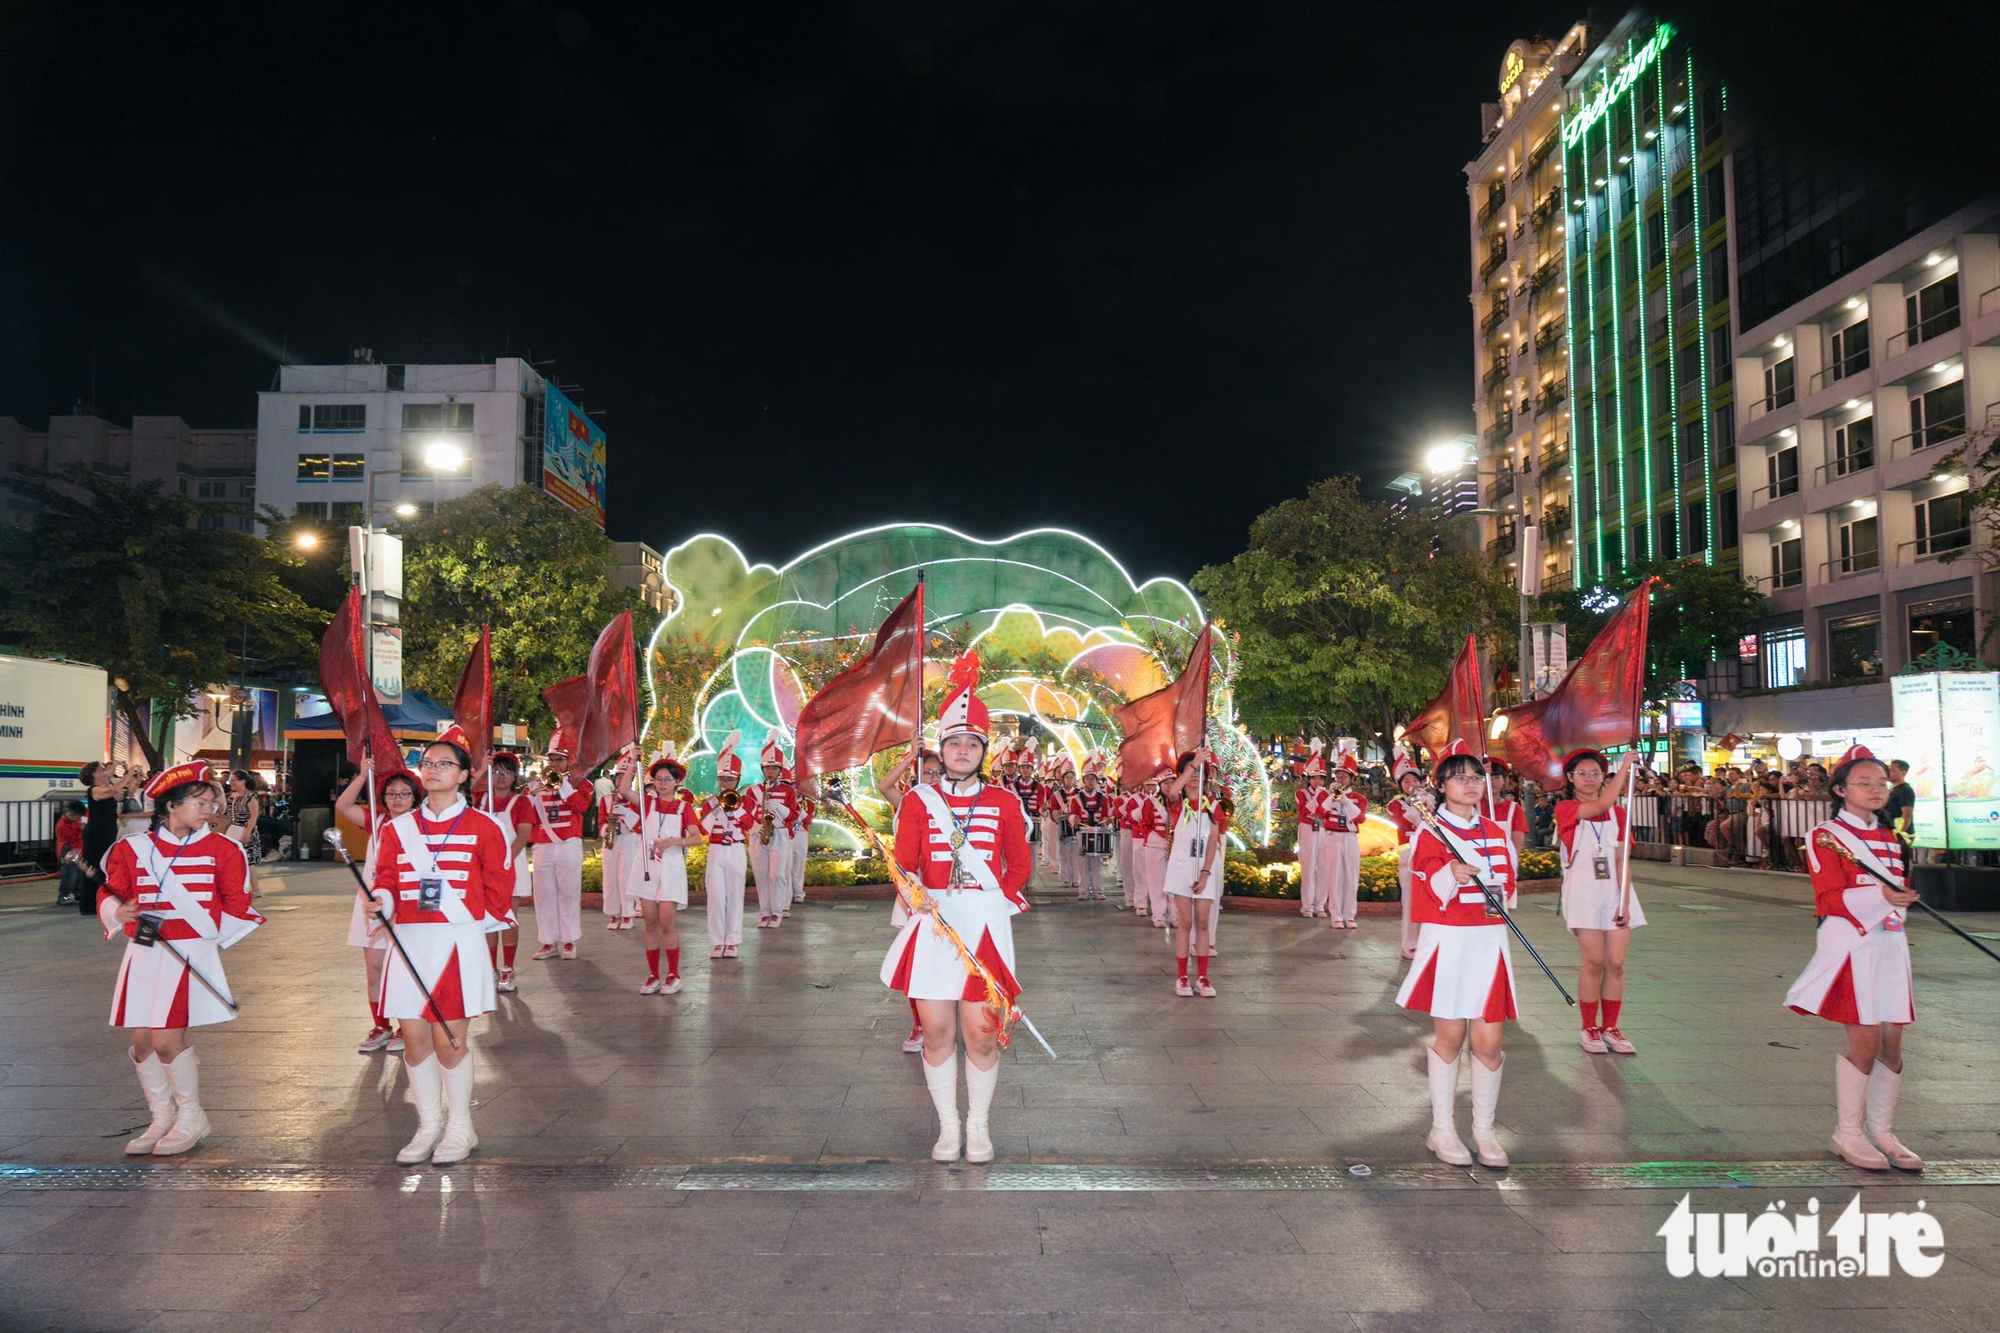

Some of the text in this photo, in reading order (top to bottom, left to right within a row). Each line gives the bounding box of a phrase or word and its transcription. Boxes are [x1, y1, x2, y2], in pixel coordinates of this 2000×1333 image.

[1501, 59, 1524, 94] OSCAR
[0, 701, 24, 718] HÌNH
[1953, 816, 1991, 824] VietinBank
